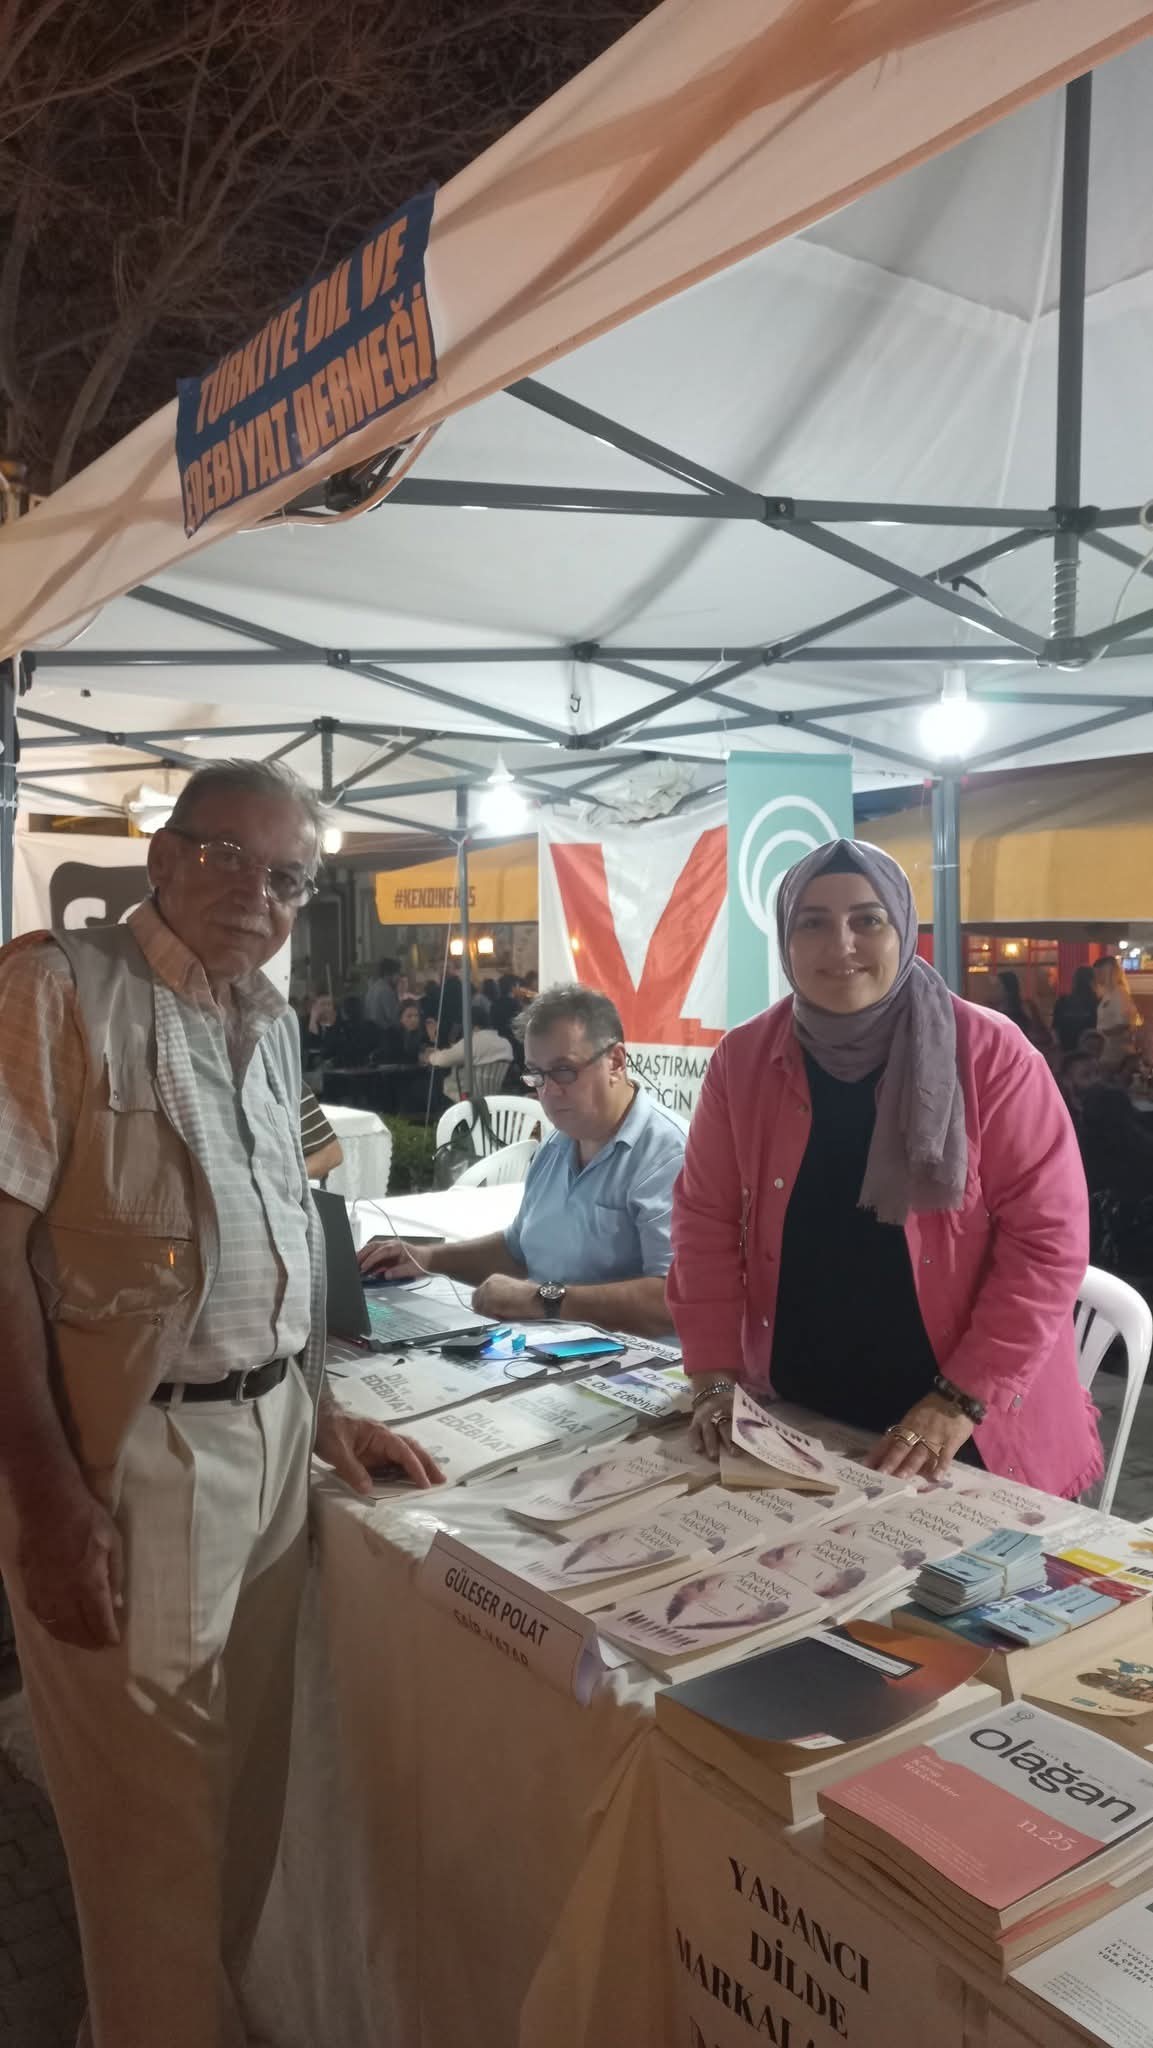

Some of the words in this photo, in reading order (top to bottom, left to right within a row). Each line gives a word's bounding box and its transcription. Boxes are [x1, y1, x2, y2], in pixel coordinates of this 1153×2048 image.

[361, 215, 408, 311] VE
[183, 398, 291, 530] EDEBİYAT
[292, 281, 432, 462] DERNEĞİ
[444, 1567, 501, 1618] GÜLESER
[500, 1602, 549, 1647] POLAT
[969, 1728, 1138, 1824] olağan
[1016, 1818, 1079, 1852] n.25
[729, 1857, 870, 1994] YABANCI
[750, 1920, 849, 2040] DİLDE
